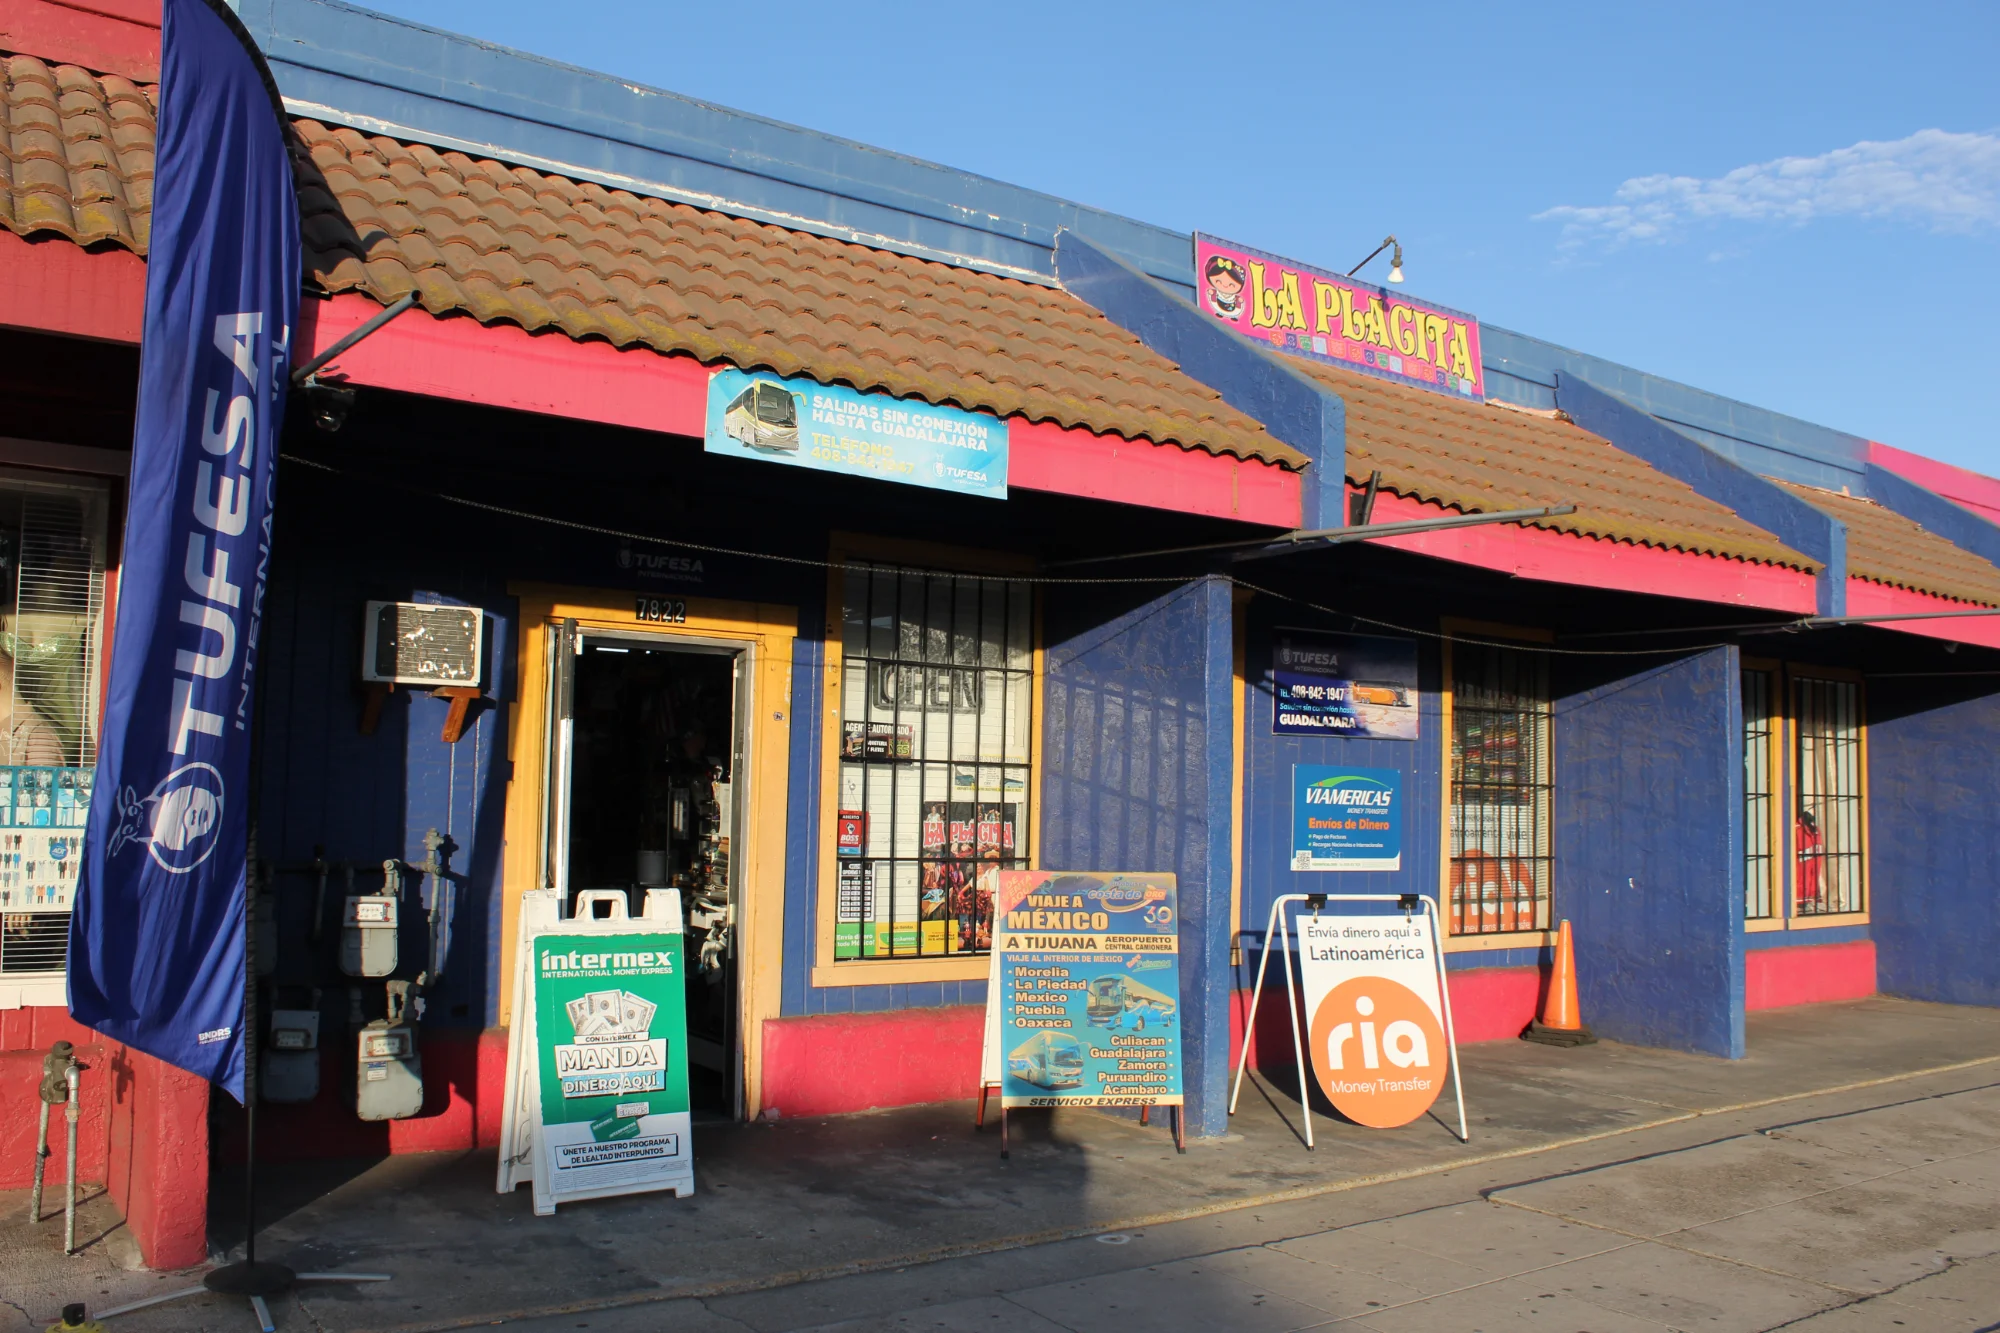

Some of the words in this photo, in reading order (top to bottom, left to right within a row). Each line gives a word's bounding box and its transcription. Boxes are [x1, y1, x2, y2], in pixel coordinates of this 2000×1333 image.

[1248, 259, 1308, 331] LA
[1312, 278, 1477, 385] PLACITA
[812, 395, 879, 419] SALIDAS
[882, 408, 908, 425] SIN
[912, 413, 988, 439] CONEXIÓN
[812, 409, 867, 431] HASTA
[871, 420, 988, 452] GUADALAJARA
[811, 432, 893, 458] TELÉFONO
[946, 466, 988, 482] TUFESA
[167, 310, 263, 756] TUFESA
[235, 324, 290, 731] INTERNAAL
[635, 553, 704, 573] TUFESA
[637, 598, 685, 621] 7822
[1292, 651, 1338, 666] TUFESA
[1291, 685, 1345, 701] 408-842-1947
[1279, 713, 1357, 728] GUADALAJARA
[845, 722, 871, 733] AGEN
[872, 723, 909, 735] AUTORIADO
[1306, 787, 1392, 806] VIAMERICAS
[1308, 817, 1342, 830] Envíos
[1344, 818, 1357, 830] de
[1359, 818, 1390, 830] Dinero
[840, 834, 859, 842] BOSS
[923, 820, 945, 848] LA
[1026, 894, 1070, 908] VIAJE
[1071, 894, 1084, 908] A
[1088, 887, 1124, 900] costa
[1125, 889, 1142, 900] de
[1144, 891, 1165, 899] ORO
[1007, 908, 1109, 931] MÉXICO
[1308, 926, 1339, 938] Envía
[1342, 926, 1380, 938] dinero
[1384, 926, 1411, 940] aquí
[1414, 928, 1421, 937] a
[851, 939, 875, 947] Méico!
[1006, 936, 1020, 949] A
[1025, 936, 1098, 949] TIJUANA
[541, 949, 673, 971] intermex
[1007, 954, 1029, 962] VIAJE
[1031, 954, 1041, 962] AL
[1043, 954, 1080, 963] INTERIOR
[1081, 955, 1092, 963] DE
[1093, 954, 1123, 963] MÉXICO
[1310, 945, 1425, 961] Latinoamérica
[542, 970, 611, 979] INTERNATIONAL
[613, 967, 640, 976] MONEY
[641, 966, 673, 975] EXPRESS
[1014, 966, 1069, 977] Morelia
[1015, 979, 1033, 990] La
[1037, 979, 1088, 990] Piedad
[1015, 992, 1068, 1002] Mexico
[1015, 1005, 1065, 1015] Puebla
[1015, 1017, 1072, 1028] Oaxaca
[1327, 995, 1430, 1070] ria
[1110, 1035, 1165, 1046] Culiacan
[560, 1045, 657, 1072] MANDA
[1090, 1047, 1166, 1060] Guadalajara
[1118, 1060, 1166, 1070] Zamora
[565, 1078, 619, 1093] DINERO
[622, 1071, 658, 1090] AQUÍ
[1098, 1072, 1167, 1082] Puruandiro
[1103, 1084, 1167, 1095] Acambaro
[1331, 1080, 1376, 1096] Money
[1377, 1077, 1432, 1092] Transfer
[1030, 1097, 1093, 1106] SERVICIO
[1097, 1097, 1157, 1106] EXPRESS
[563, 1147, 587, 1156] ÚNETE
[594, 1143, 628, 1152] NUESTRO
[629, 1138, 671, 1148] PROGRAMA
[582, 1153, 614, 1163] LEALTAD
[614, 1147, 664, 1159] INTERPUNTOS
